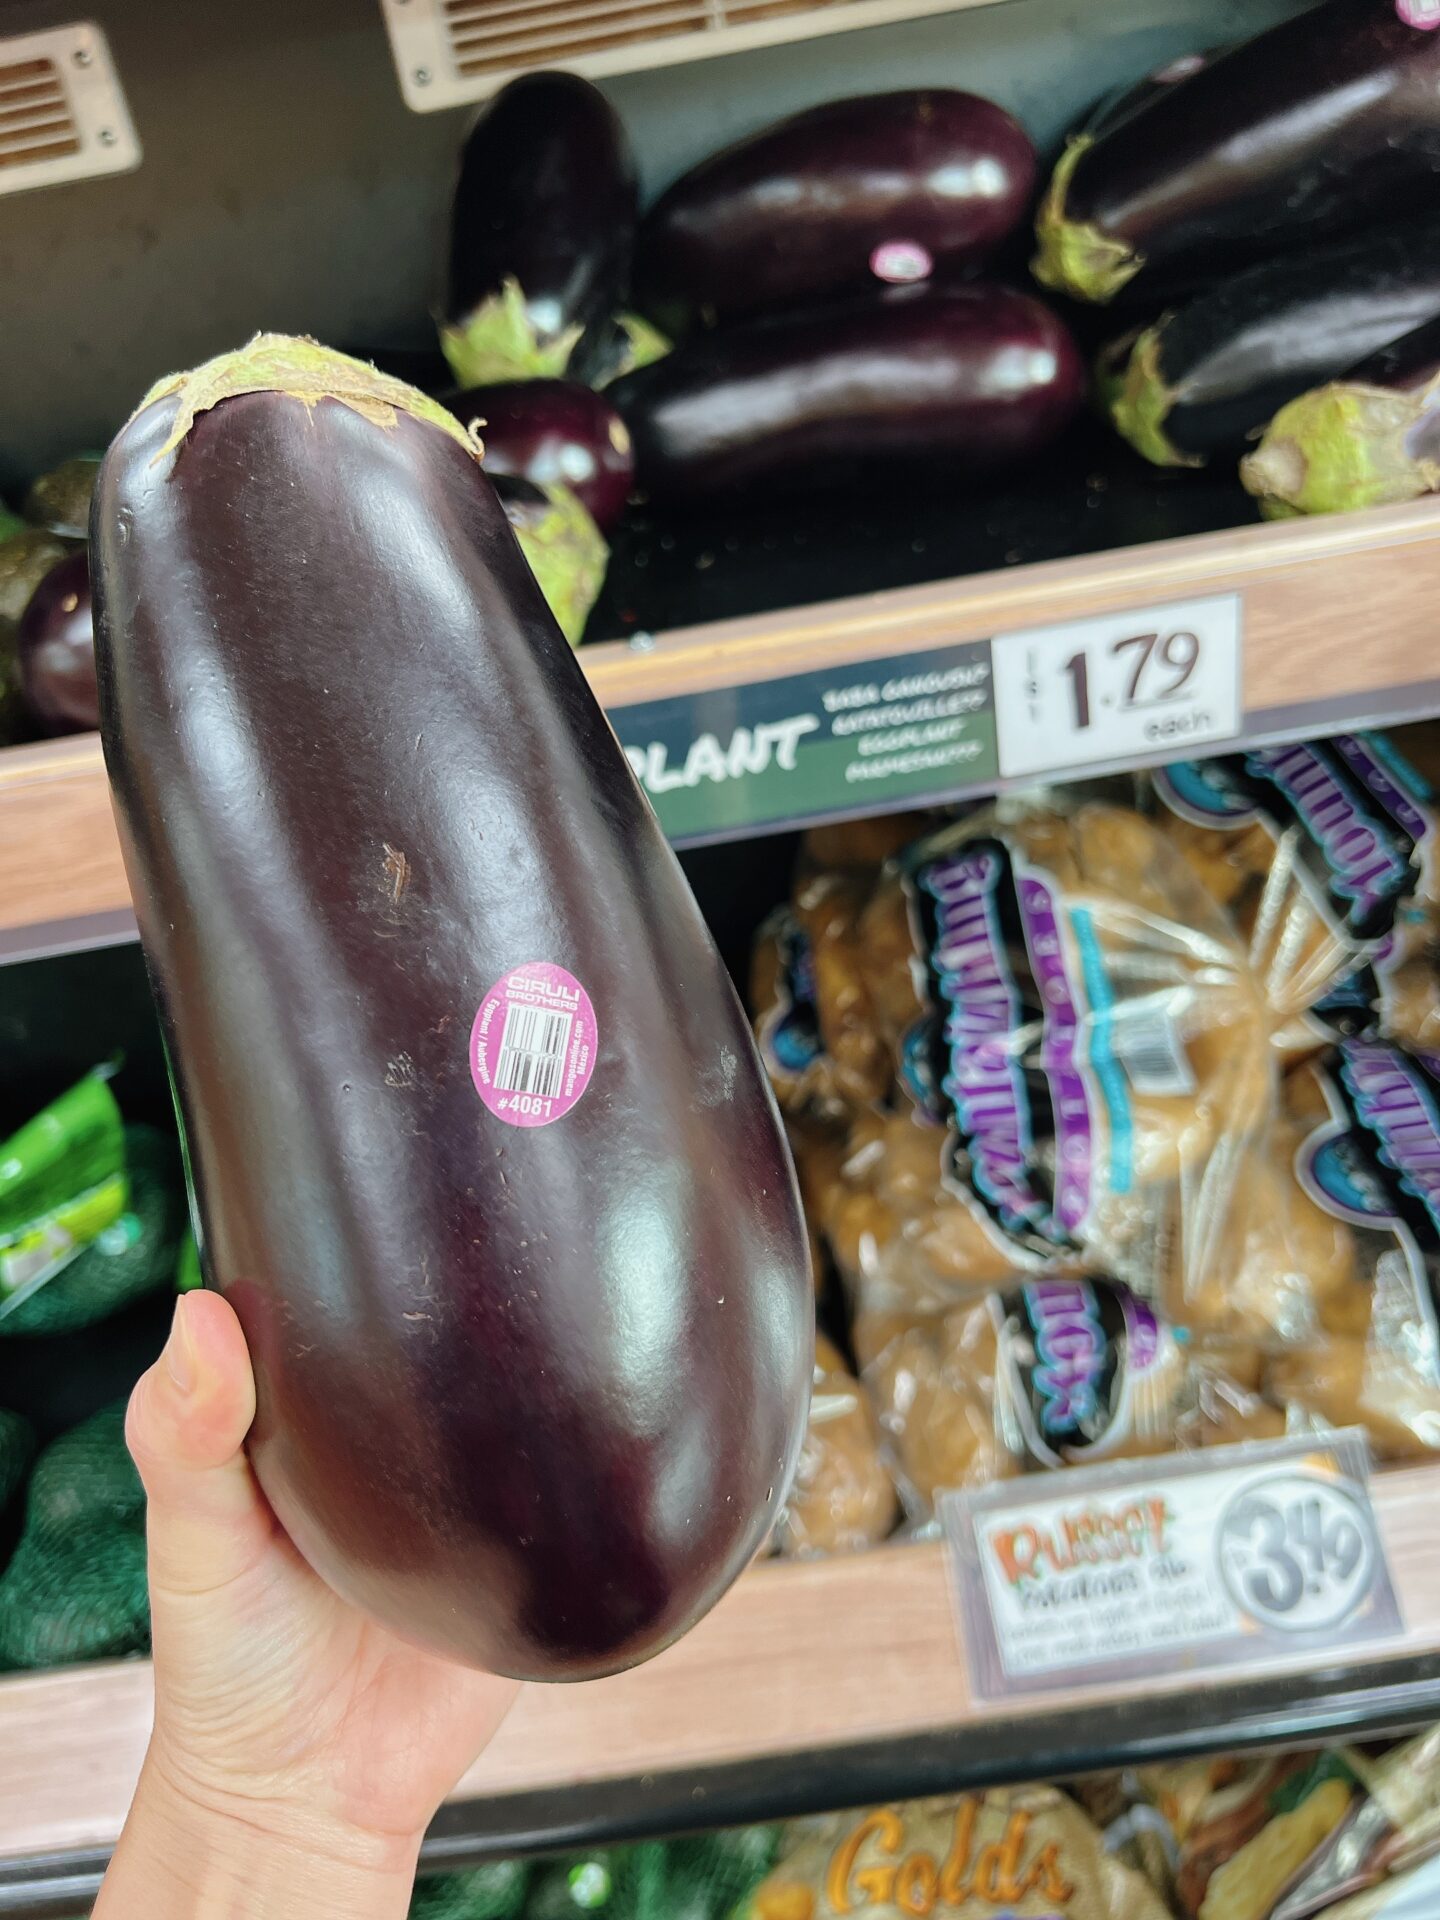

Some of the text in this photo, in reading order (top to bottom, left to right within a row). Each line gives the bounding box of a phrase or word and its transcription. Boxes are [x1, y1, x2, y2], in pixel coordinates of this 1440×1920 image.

[1064, 632, 1200, 729] 1.79
[505, 989, 578, 1011] BROTHERS
[507, 976, 580, 1002] CIRULI
[479, 998, 500, 1034] Eggplant
[477, 1040, 491, 1085] Aubergine
[497, 1093, 553, 1118] #4081
[827, 1798, 1074, 1916] Golds
